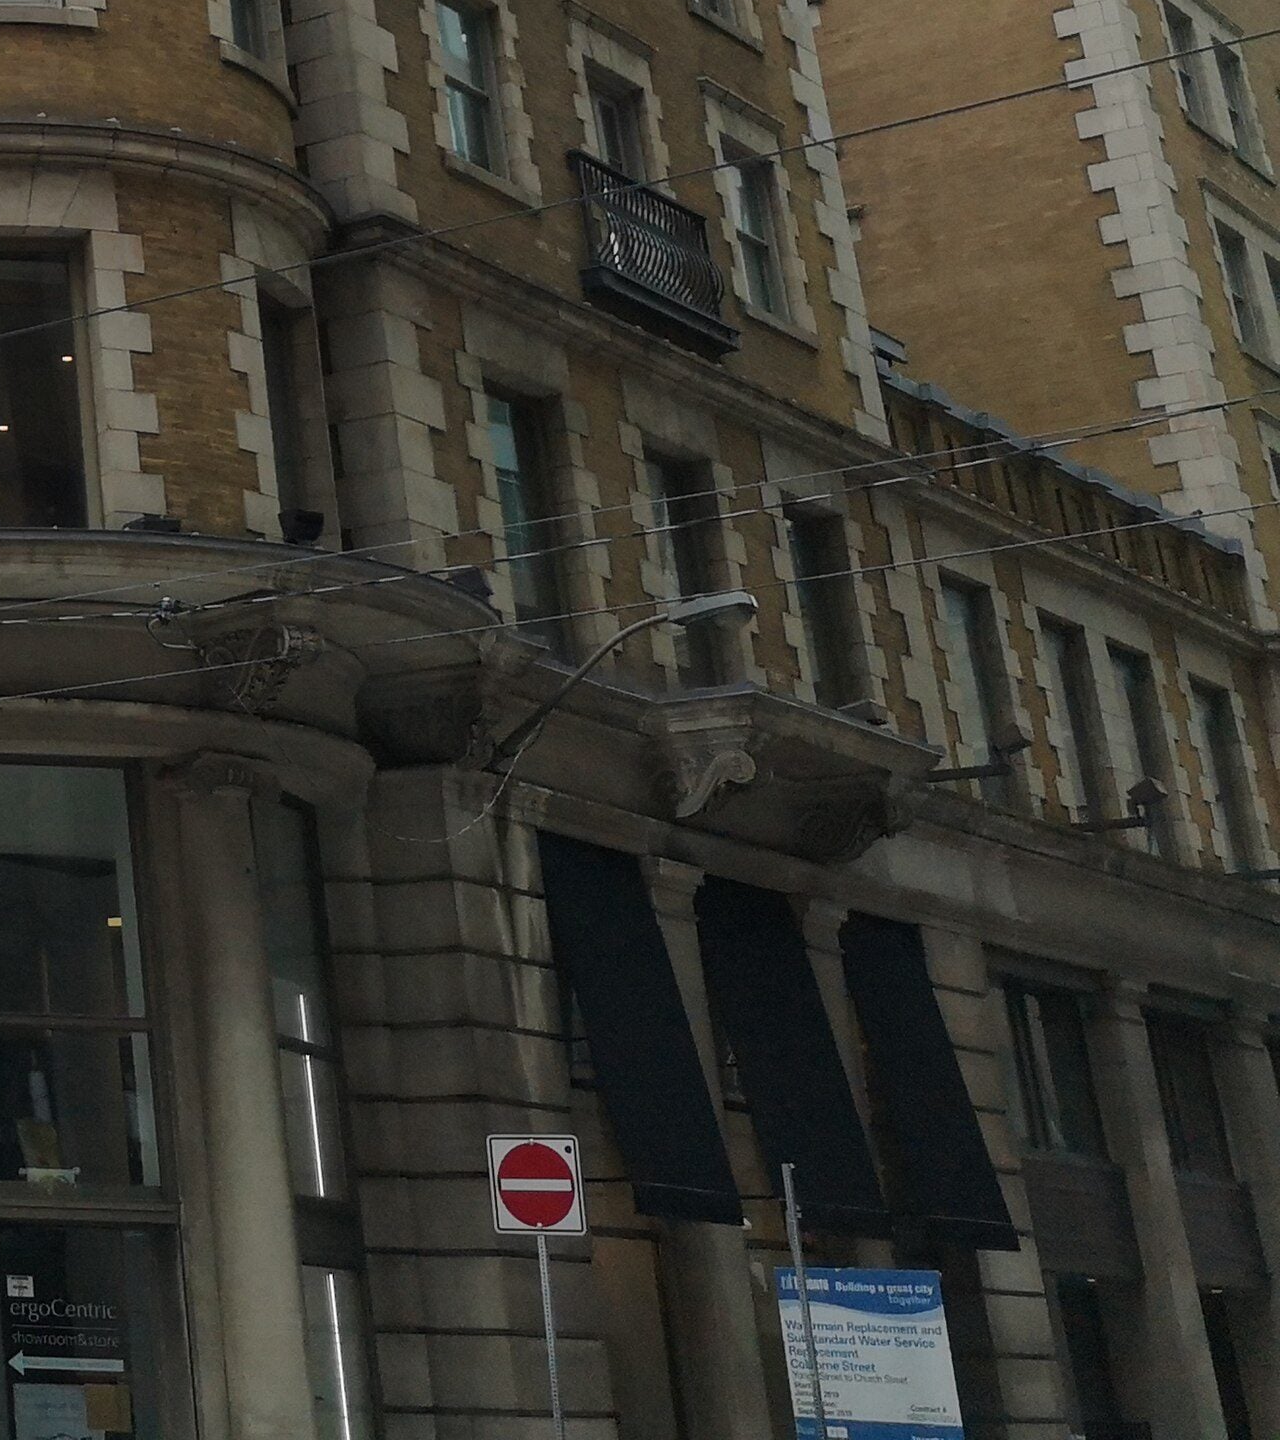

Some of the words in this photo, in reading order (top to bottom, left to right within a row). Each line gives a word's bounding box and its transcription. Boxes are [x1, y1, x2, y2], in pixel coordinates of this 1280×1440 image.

[835, 1281, 876, 1294] Building
[886, 1283, 914, 1295] great
[915, 1284, 934, 1296] city
[888, 1295, 931, 1306] together
[10, 1298, 117, 1322] ergoCentric
[784, 1319, 844, 1333] Warmain
[847, 1321, 917, 1336] Replacement
[921, 1325, 942, 1336] and
[858, 1336, 890, 1348] Water
[894, 1336, 935, 1349] Service
[842, 1361, 876, 1373] Street
